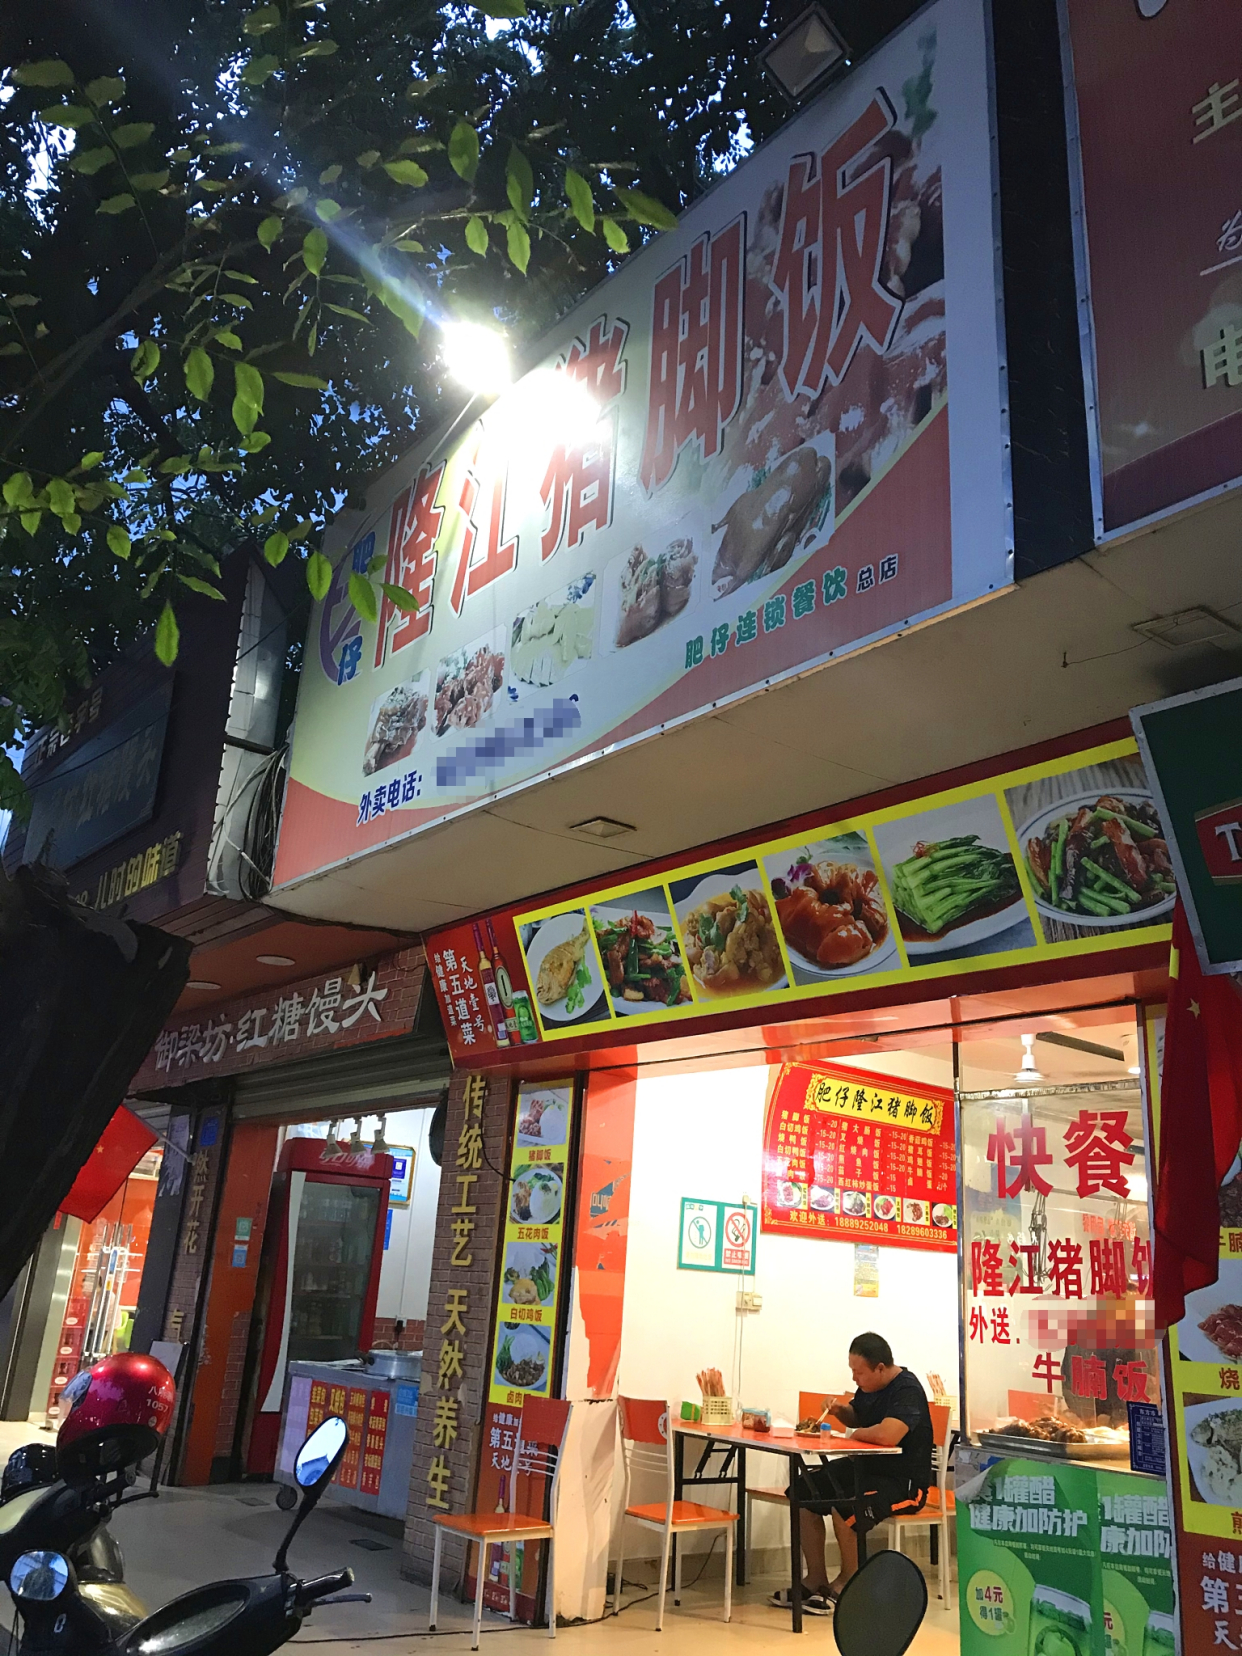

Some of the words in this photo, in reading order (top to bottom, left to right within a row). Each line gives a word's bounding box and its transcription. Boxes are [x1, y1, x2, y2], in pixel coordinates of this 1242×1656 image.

[373, 87, 906, 669] 隆江猪脚饭
[685, 566, 848, 669] 肥仔连锁餐饮
[856, 553, 899, 594] 总店
[442, 948, 477, 1046] 第五道菜
[460, 956, 485, 1032] 天地壹号
[815, 1082, 935, 1126] 肥仔隆江猪脚饭
[781, 1110, 811, 1124] 猪脚饭
[779, 1121, 809, 1135] 白切鸡饭
[841, 1121, 882, 1138] 猪大肠饭
[777, 1132, 808, 1147] 烧鸭饭
[840, 1132, 881, 1149] 叉烧饭
[528, 1149, 552, 1162] 猪脚饭
[777, 1144, 807, 1158] 白切鸭饭
[838, 1143, 880, 1160] 红烧肉饭
[986, 1110, 1136, 1200] 快餐
[449, 1074, 487, 1268] 传统工艺
[838, 1176, 880, 1192] 西红柿炒蛋饭
[517, 1227, 549, 1241] 五花肉饭
[835, 1217, 889, 1233] 18889252048
[897, 1224, 948, 1240] 18289603336
[510, 1307, 543, 1322] 白切鸡饭
[1032, 1352, 1151, 1403] 牛腩饭
[425, 1288, 468, 1511] 天然养生
[506, 1390, 532, 1405] 卤肉
[969, 1503, 1088, 1537] 健康加防护
[975, 1585, 1004, 1604] 加4元
